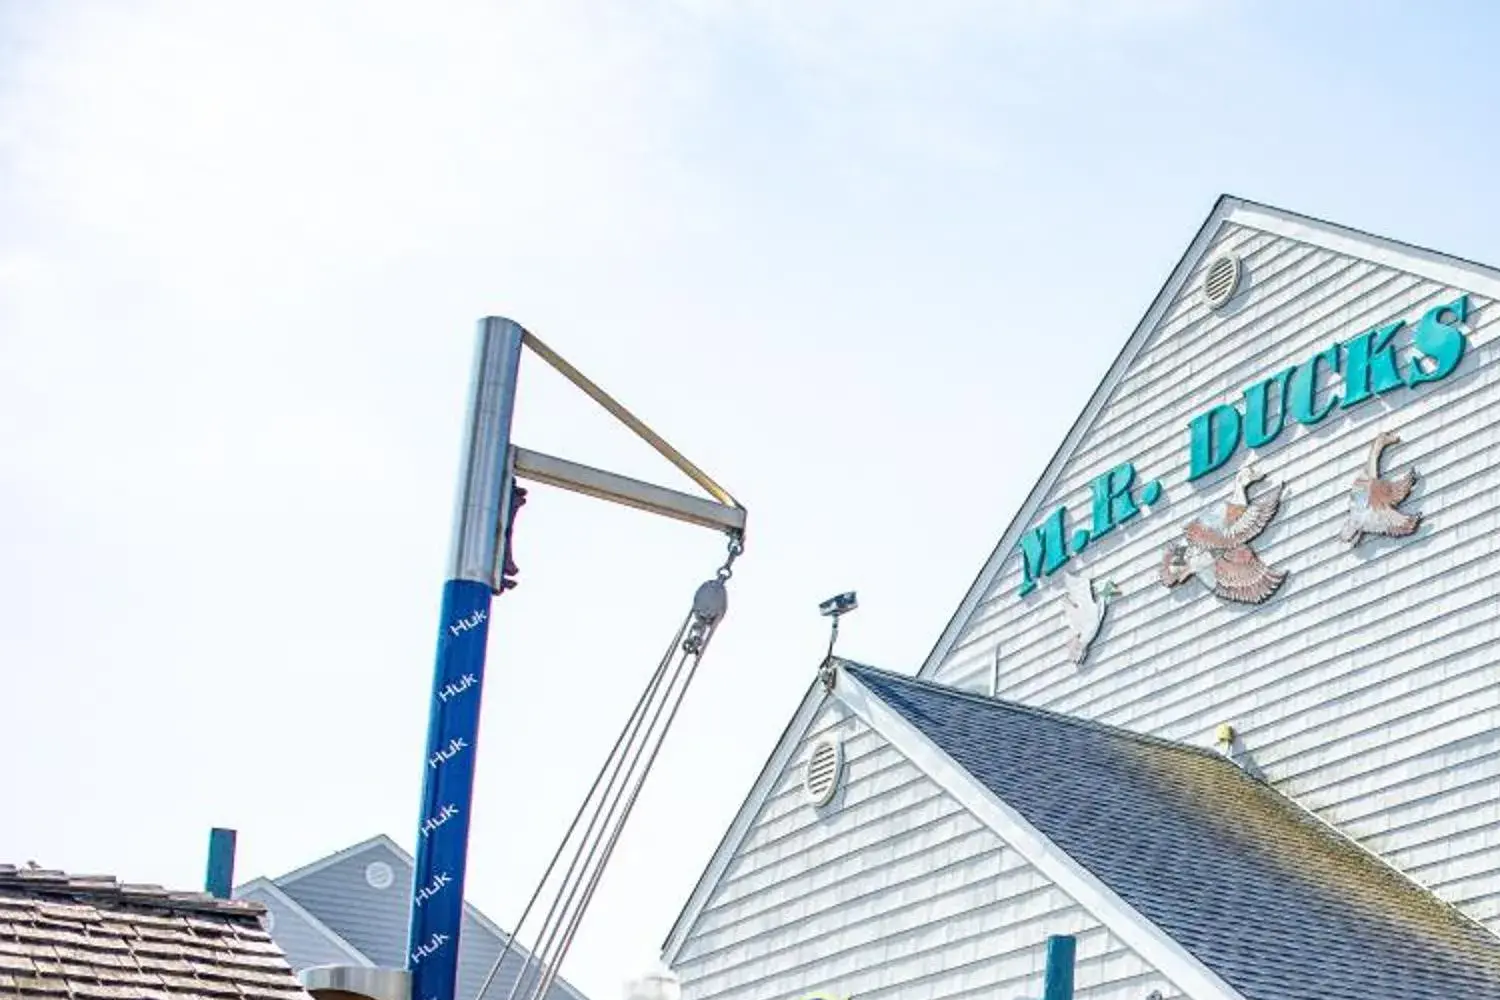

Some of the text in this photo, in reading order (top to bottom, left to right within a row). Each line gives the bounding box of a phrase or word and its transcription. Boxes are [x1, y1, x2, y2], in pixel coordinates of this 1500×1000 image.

[1016, 294, 1469, 598] M.R. DUCKS
[450, 609, 487, 636] Huk
[439, 673, 479, 702] Huk
[429, 737, 468, 769] Huk
[420, 803, 459, 837] Huk
[415, 872, 452, 907] Huk
[411, 933, 449, 964] Huk
